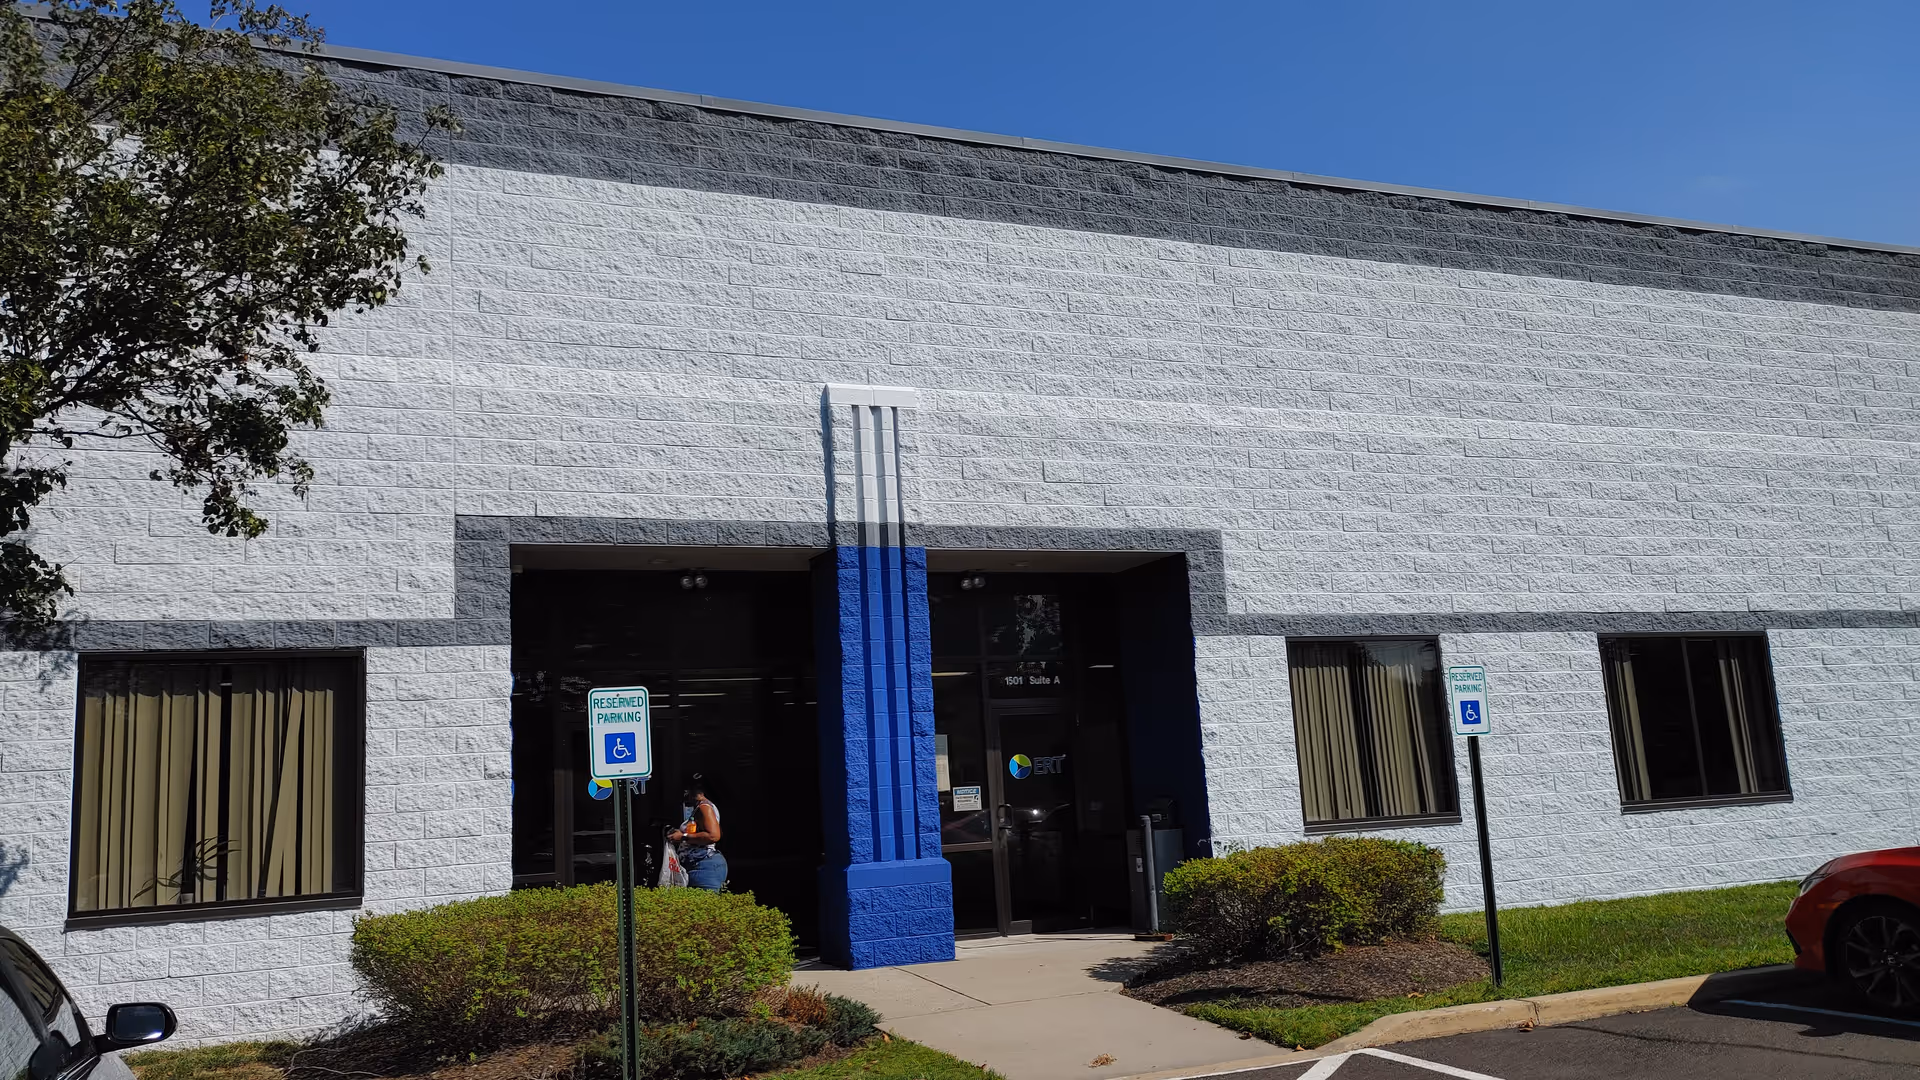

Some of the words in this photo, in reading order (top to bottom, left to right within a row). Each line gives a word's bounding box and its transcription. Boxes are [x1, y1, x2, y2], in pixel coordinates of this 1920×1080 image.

[1005, 676, 1024, 686] 1501
[1029, 675, 1051, 685] Suite
[1053, 675, 1061, 684] A
[1451, 672, 1483, 681] RESERVED
[1454, 684, 1482, 693] PARKING
[593, 696, 644, 709] RESERVED
[597, 711, 641, 724] PARKING
[1033, 755, 1066, 775] ERT
